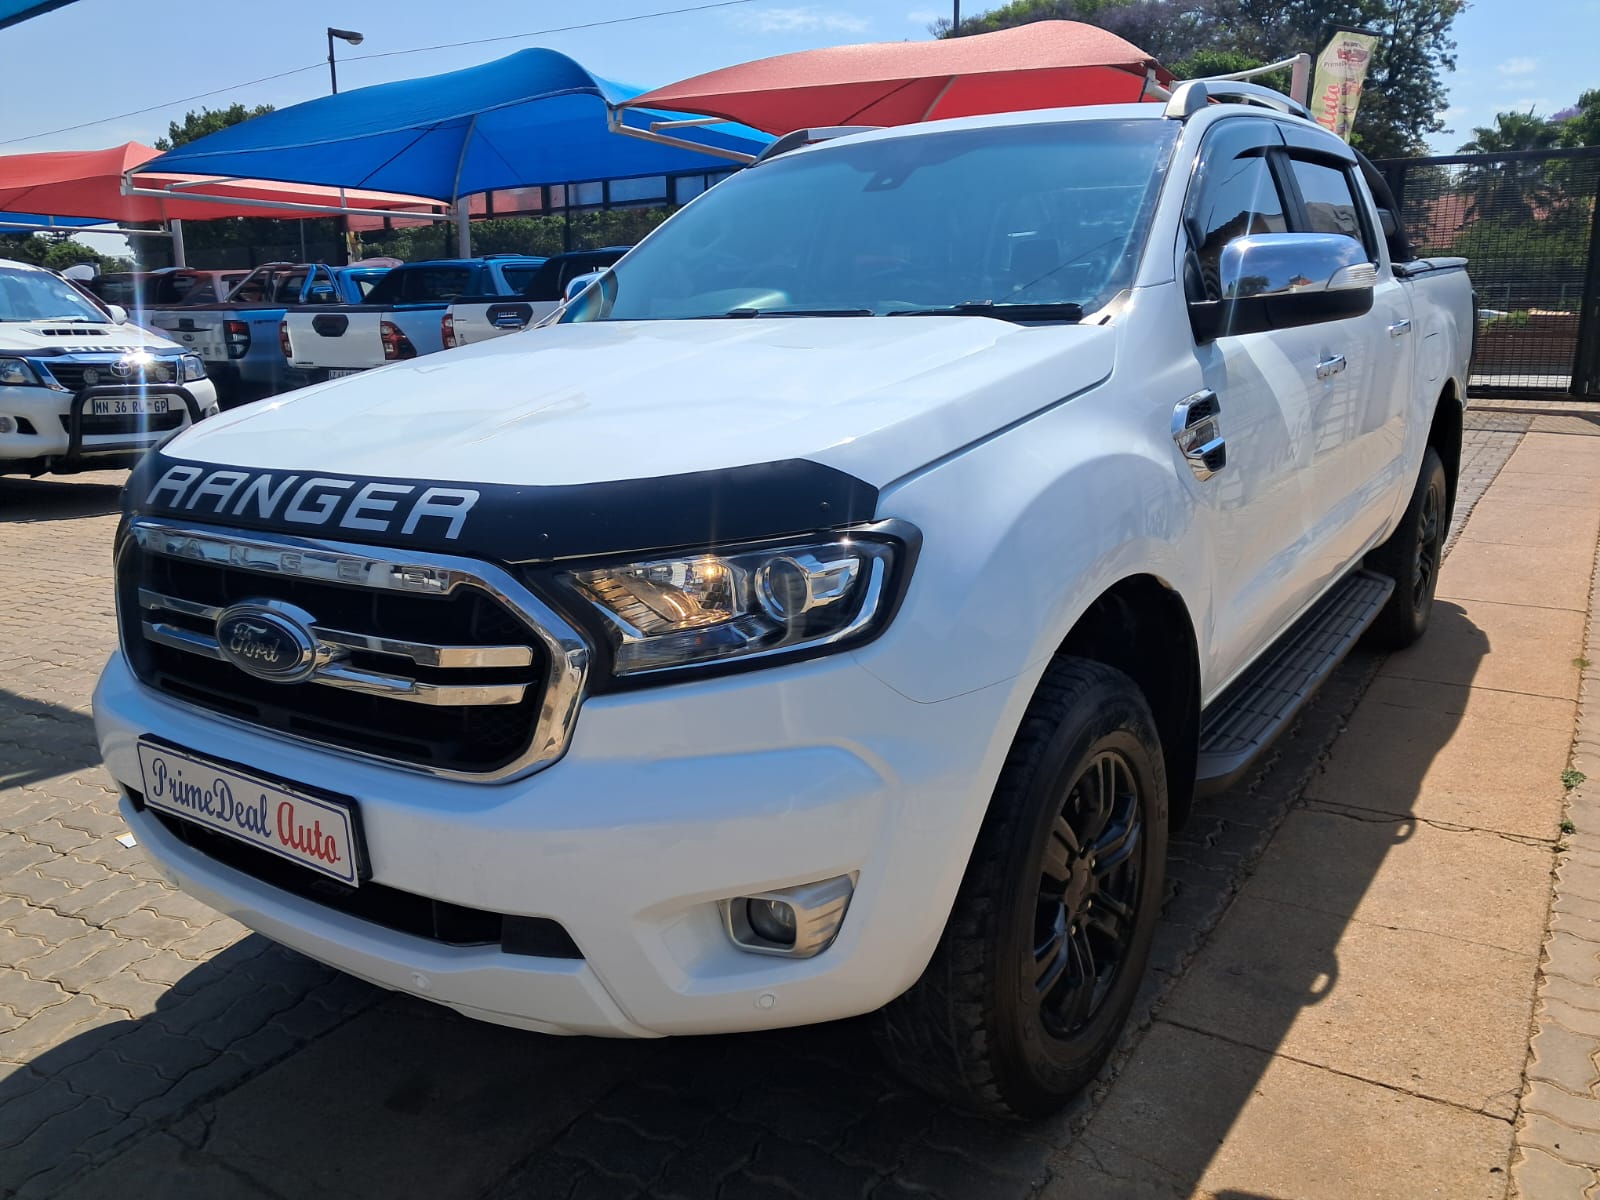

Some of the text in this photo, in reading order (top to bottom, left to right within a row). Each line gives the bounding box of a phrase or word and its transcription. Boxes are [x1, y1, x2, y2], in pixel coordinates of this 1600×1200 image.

[95, 401, 109, 413] MN
[114, 401, 127, 413] 36
[154, 401, 166, 413] GP
[146, 465, 480, 540] RANGER
[231, 622, 280, 662] Ford
[152, 757, 341, 864] PrimeDeal Auto
